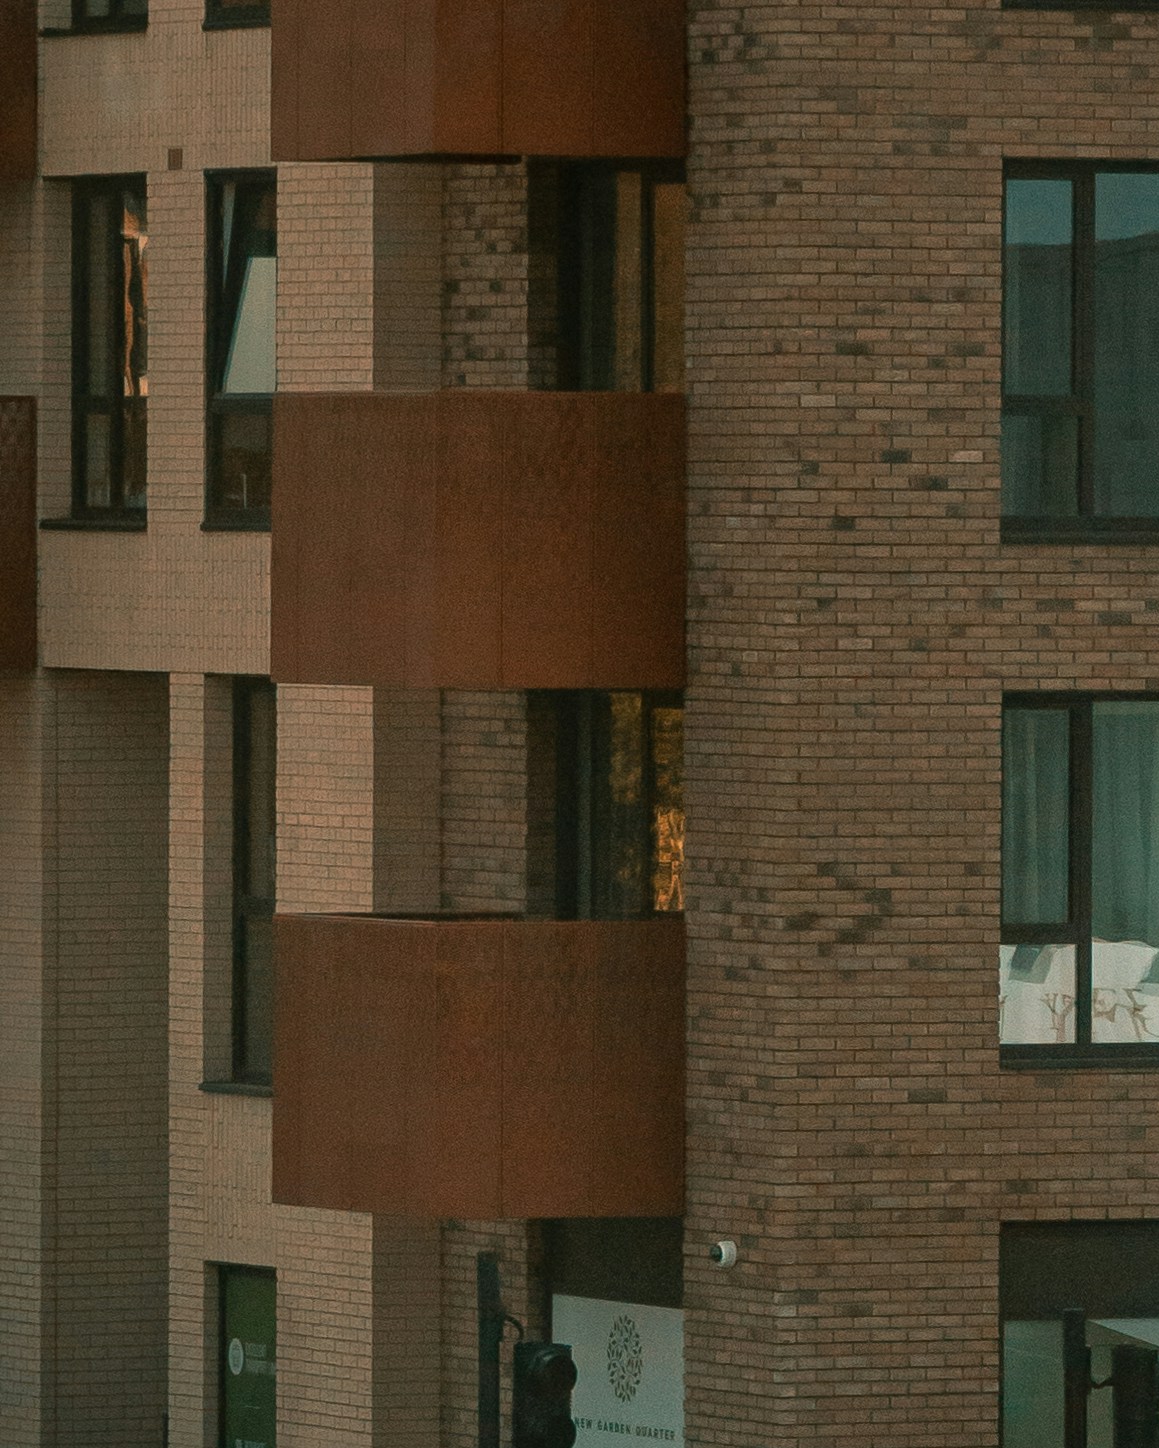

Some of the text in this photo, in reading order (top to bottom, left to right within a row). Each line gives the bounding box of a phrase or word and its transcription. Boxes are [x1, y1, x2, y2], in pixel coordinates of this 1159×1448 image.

[574, 1417, 676, 1440] NEW GARDEN QUARTER
